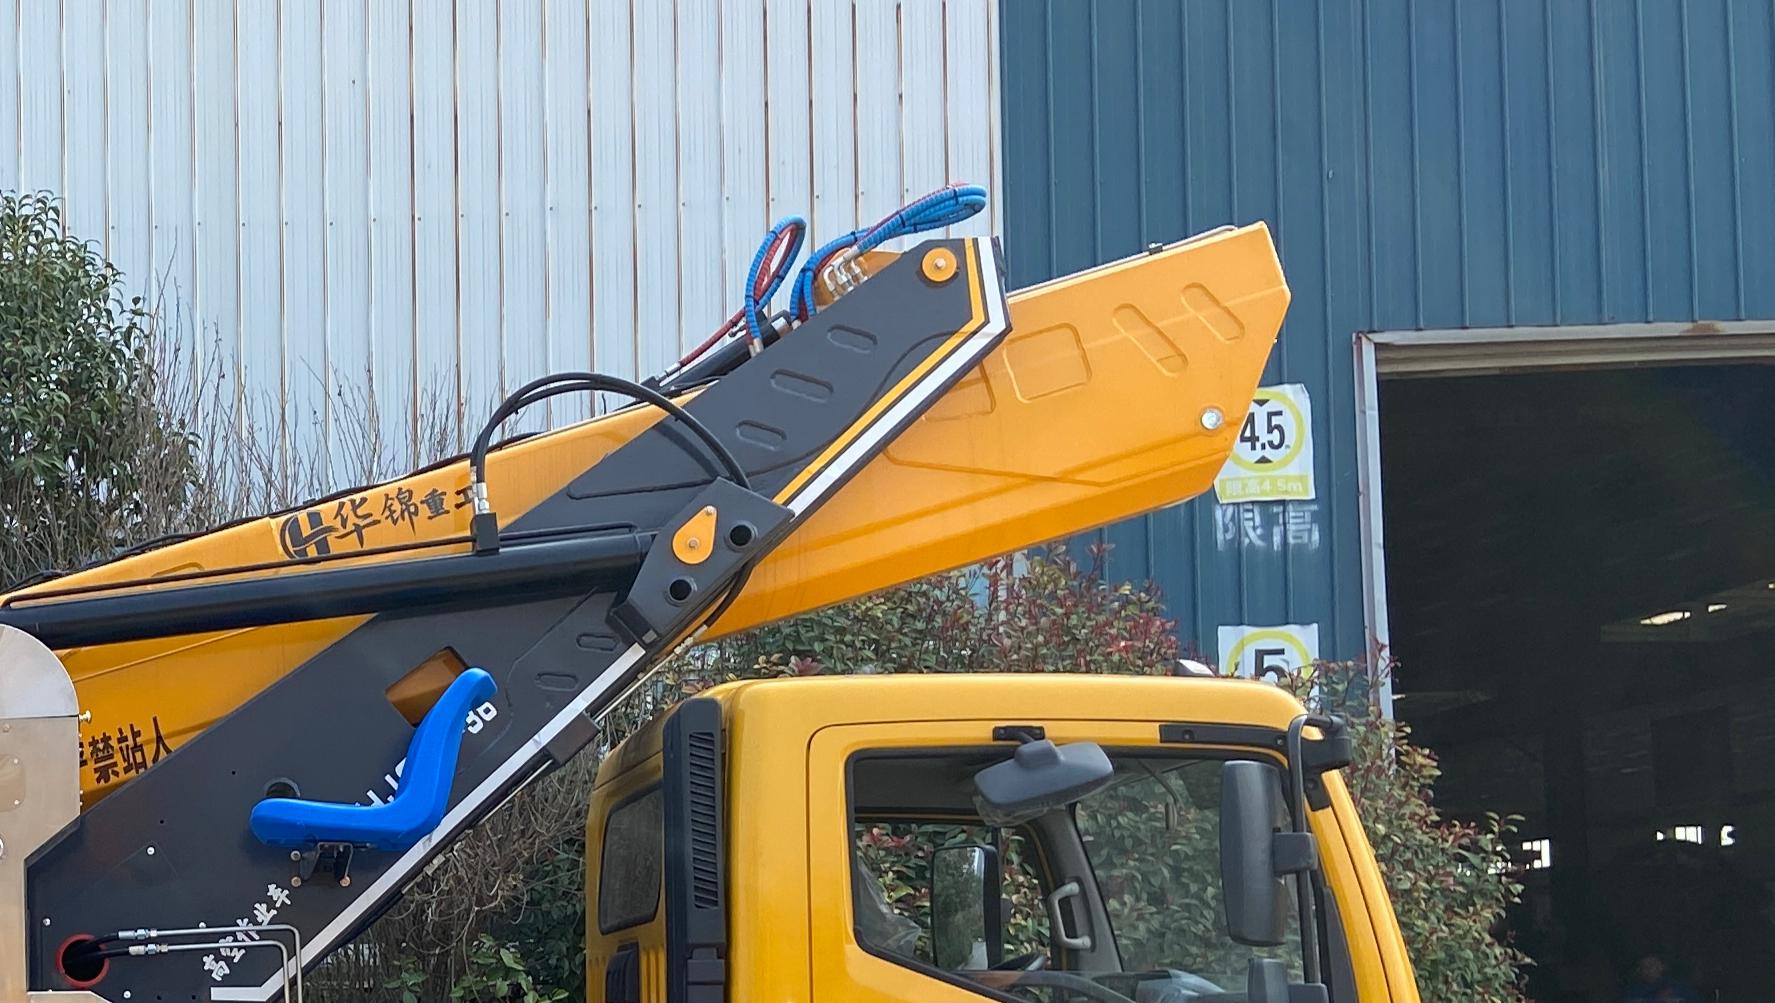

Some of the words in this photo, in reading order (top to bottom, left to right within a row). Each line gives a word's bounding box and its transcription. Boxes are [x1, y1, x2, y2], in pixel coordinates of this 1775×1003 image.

[1239, 410, 1285, 451] 4.5
[1215, 502, 1320, 551] 限高
[202, 883, 292, 981] 高空作业车
